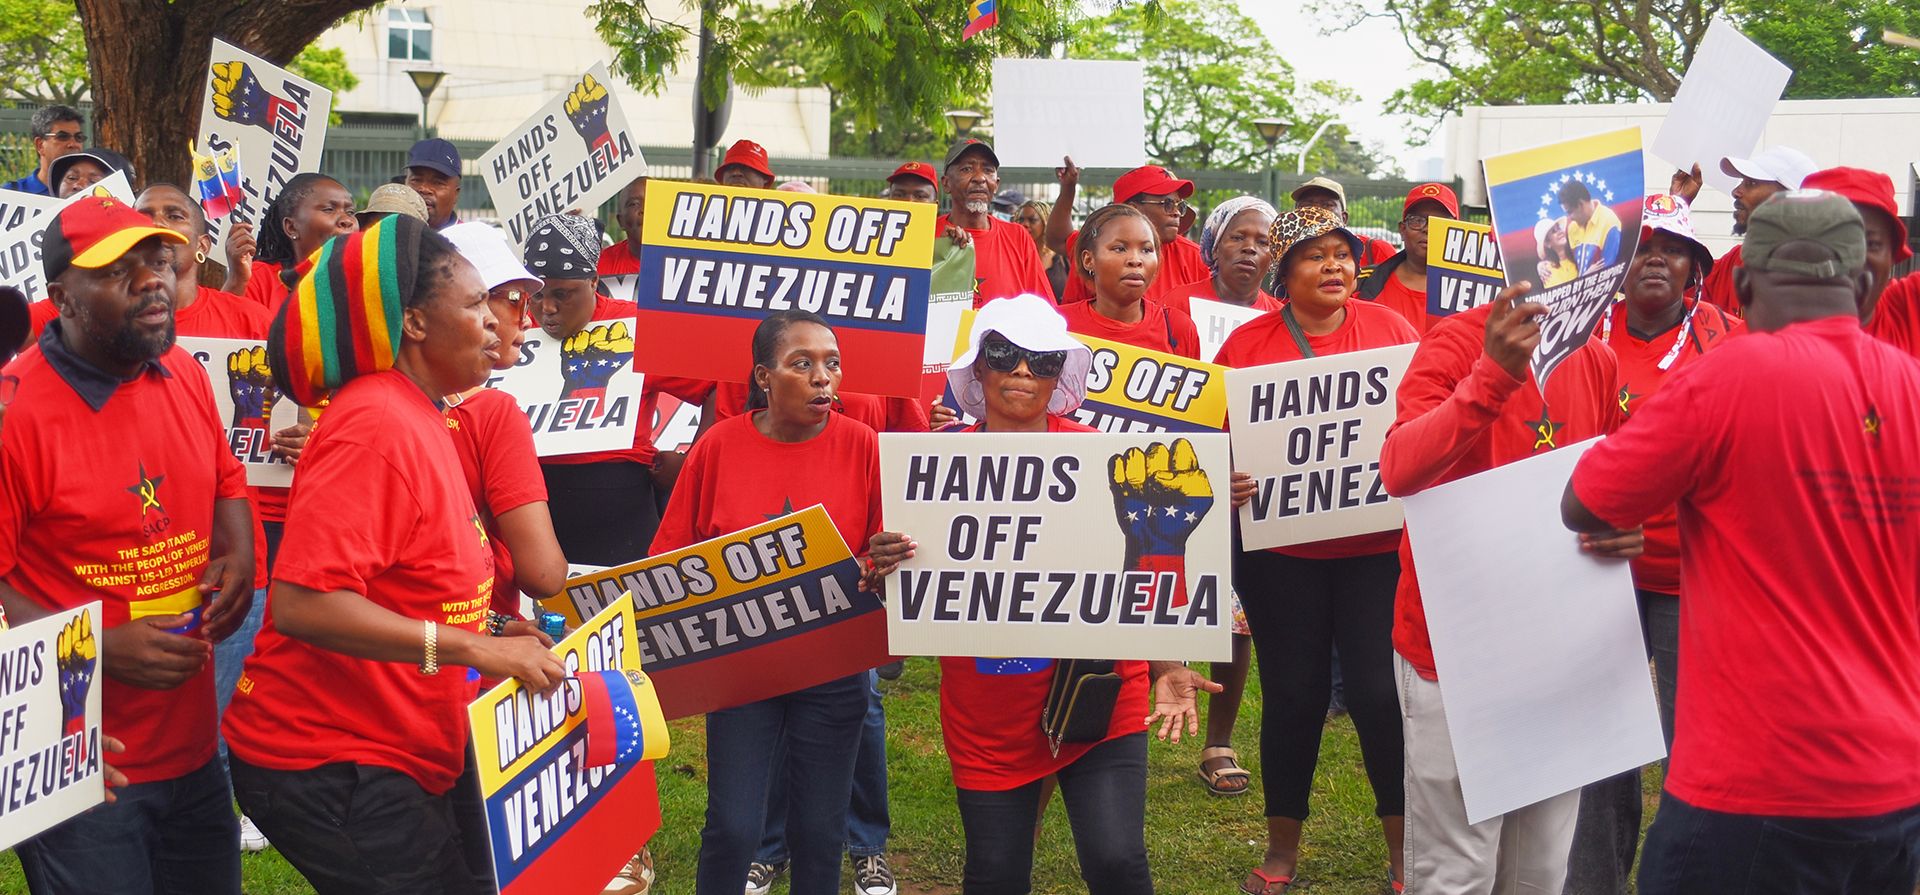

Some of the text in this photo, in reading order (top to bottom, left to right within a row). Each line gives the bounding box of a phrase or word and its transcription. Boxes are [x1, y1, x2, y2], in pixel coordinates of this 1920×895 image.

[493, 114, 558, 184] HANDS
[518, 154, 552, 200] OFF
[508, 131, 634, 245] VENEZUELA
[668, 192, 910, 256] HANDS OFF
[661, 257, 907, 321] VENEZUELA
[1572, 279, 1584, 294] BY
[1584, 273, 1599, 290] THE
[1125, 356, 1209, 412] OFF
[1250, 366, 1389, 423] HANDS
[1287, 419, 1362, 465] OFF
[906, 455, 1081, 502] HANDS
[1252, 462, 1389, 521] VENEZ
[118, 548, 139, 560] THE
[142, 541, 166, 556] SACP
[142, 517, 171, 538] SACP
[723, 523, 807, 582] OFF
[947, 514, 1042, 562] OFF
[74, 564, 108, 576] WITH
[111, 563, 134, 573] THE
[171, 549, 184, 561] OF
[136, 573, 195, 596] AGGRESSION.
[442, 601, 469, 612] WITH
[471, 597, 483, 609] THE
[446, 609, 482, 624] AGAINST
[636, 575, 852, 665] ENEZUELA
[900, 570, 1219, 627] VENEZUELA
[0, 639, 45, 698] NDS
[586, 612, 624, 672] OFF
[0, 703, 28, 757] FF
[0, 726, 99, 817] EZUELA
[504, 736, 616, 861] VENEZ
